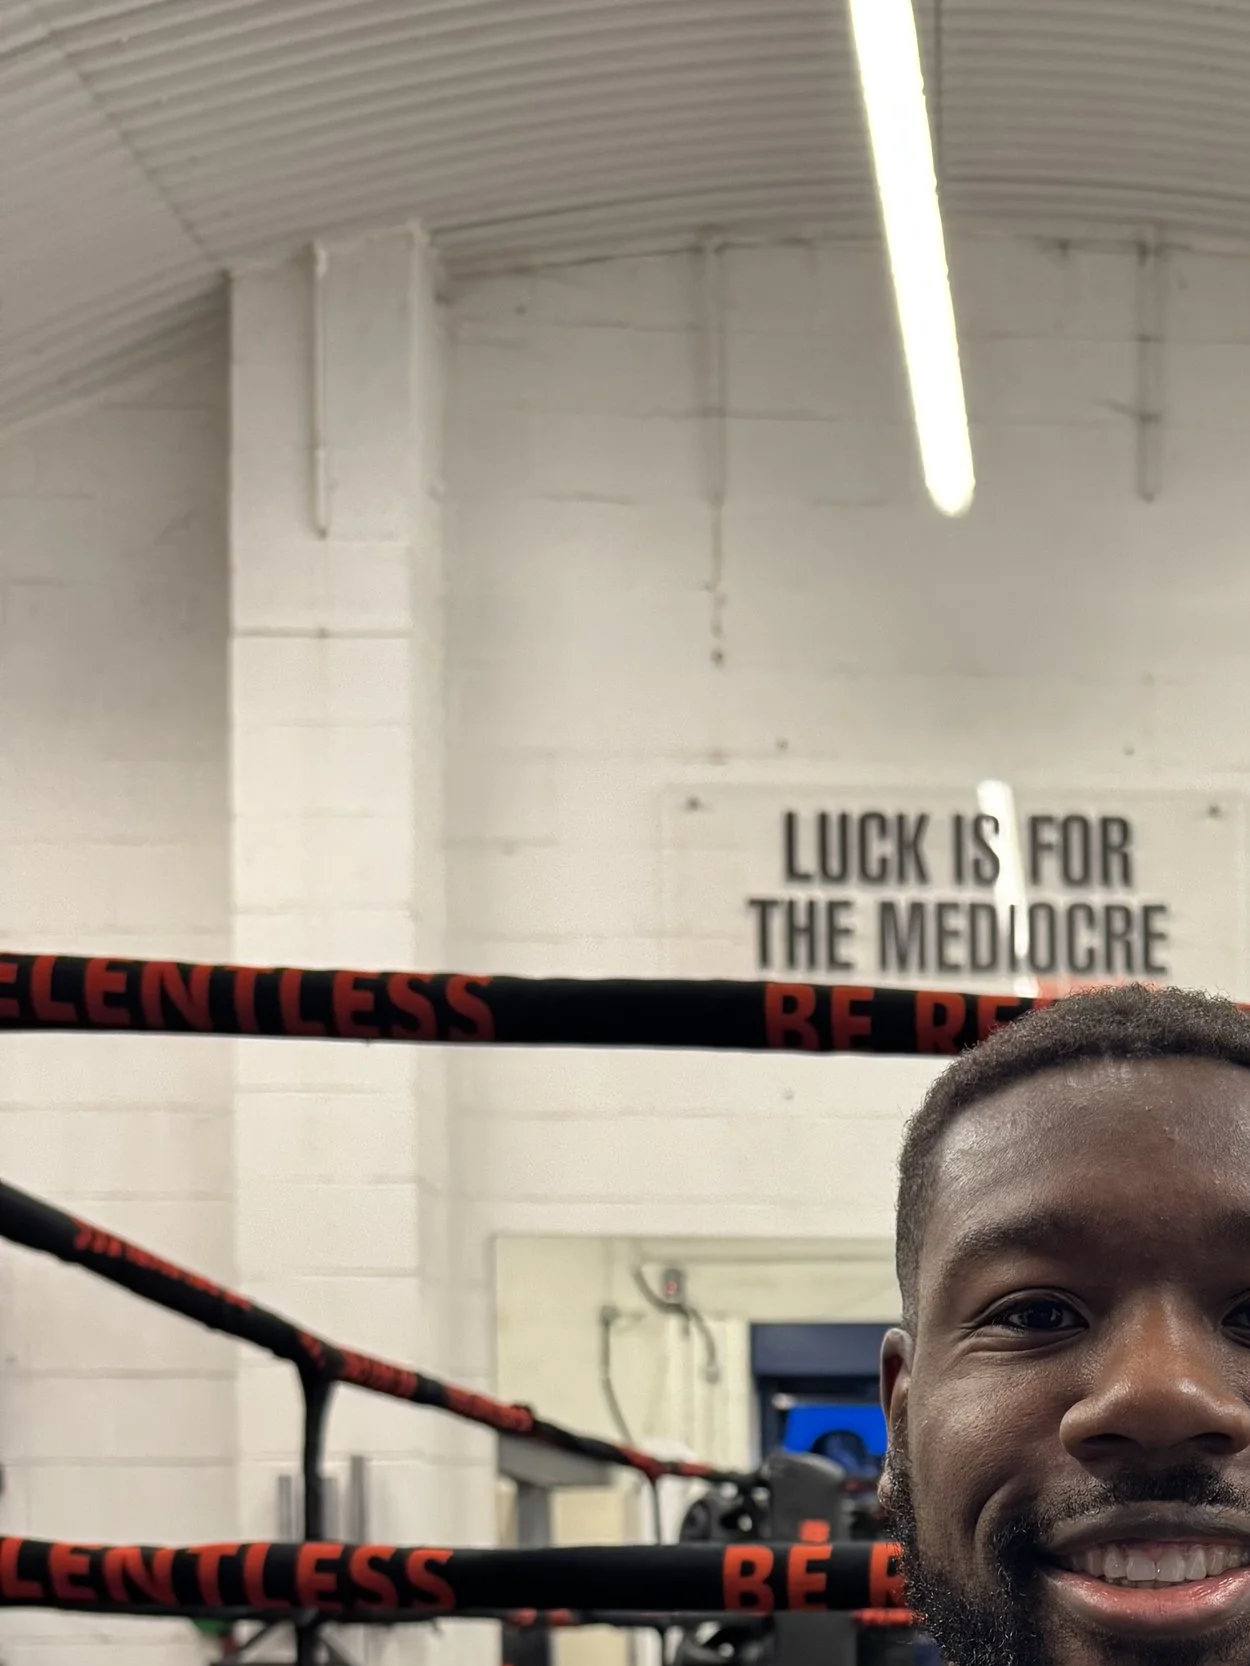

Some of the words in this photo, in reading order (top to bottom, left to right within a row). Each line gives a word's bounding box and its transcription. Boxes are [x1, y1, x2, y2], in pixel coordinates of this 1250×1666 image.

[784, 811, 931, 886] LUCK
[953, 813, 1001, 886] IS
[1027, 813, 1133, 887] FOR
[748, 898, 855, 973] THE
[879, 900, 1169, 975] MEDIOCRE
[764, 982, 875, 1053] BE
[722, 1543, 833, 1616] BE
